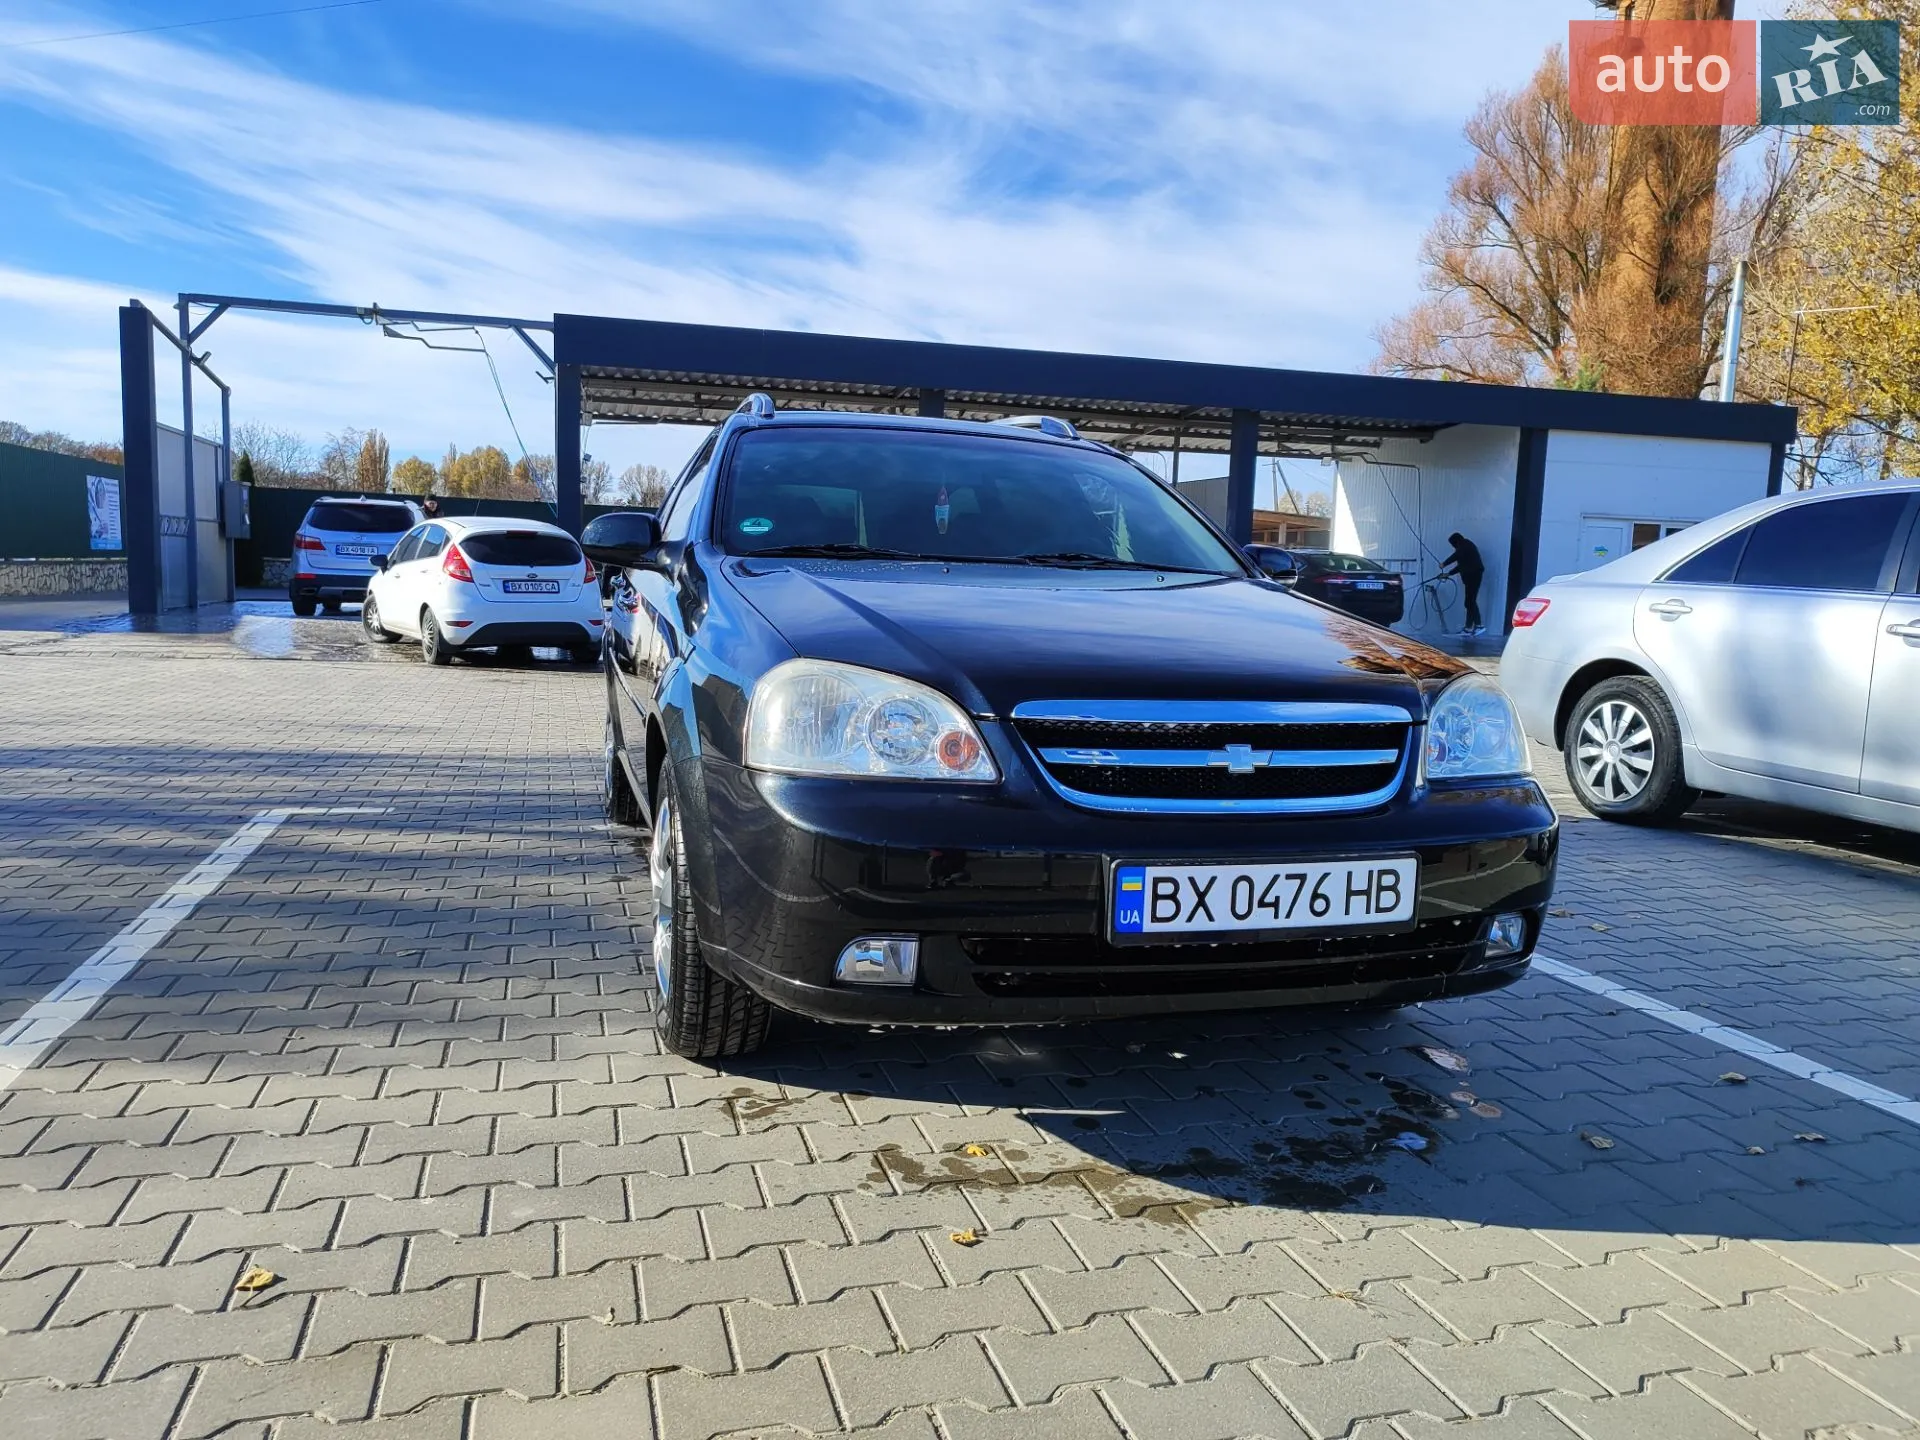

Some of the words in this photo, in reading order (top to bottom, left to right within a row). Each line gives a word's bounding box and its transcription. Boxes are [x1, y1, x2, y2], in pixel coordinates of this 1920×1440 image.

[510, 582, 522, 591] BX
[524, 582, 543, 591] 0105
[544, 583, 557, 591] CA
[1150, 875, 1218, 923] BX
[1230, 872, 1332, 921] 0476
[1344, 869, 1401, 916] HB
[1119, 909, 1140, 924] UA
